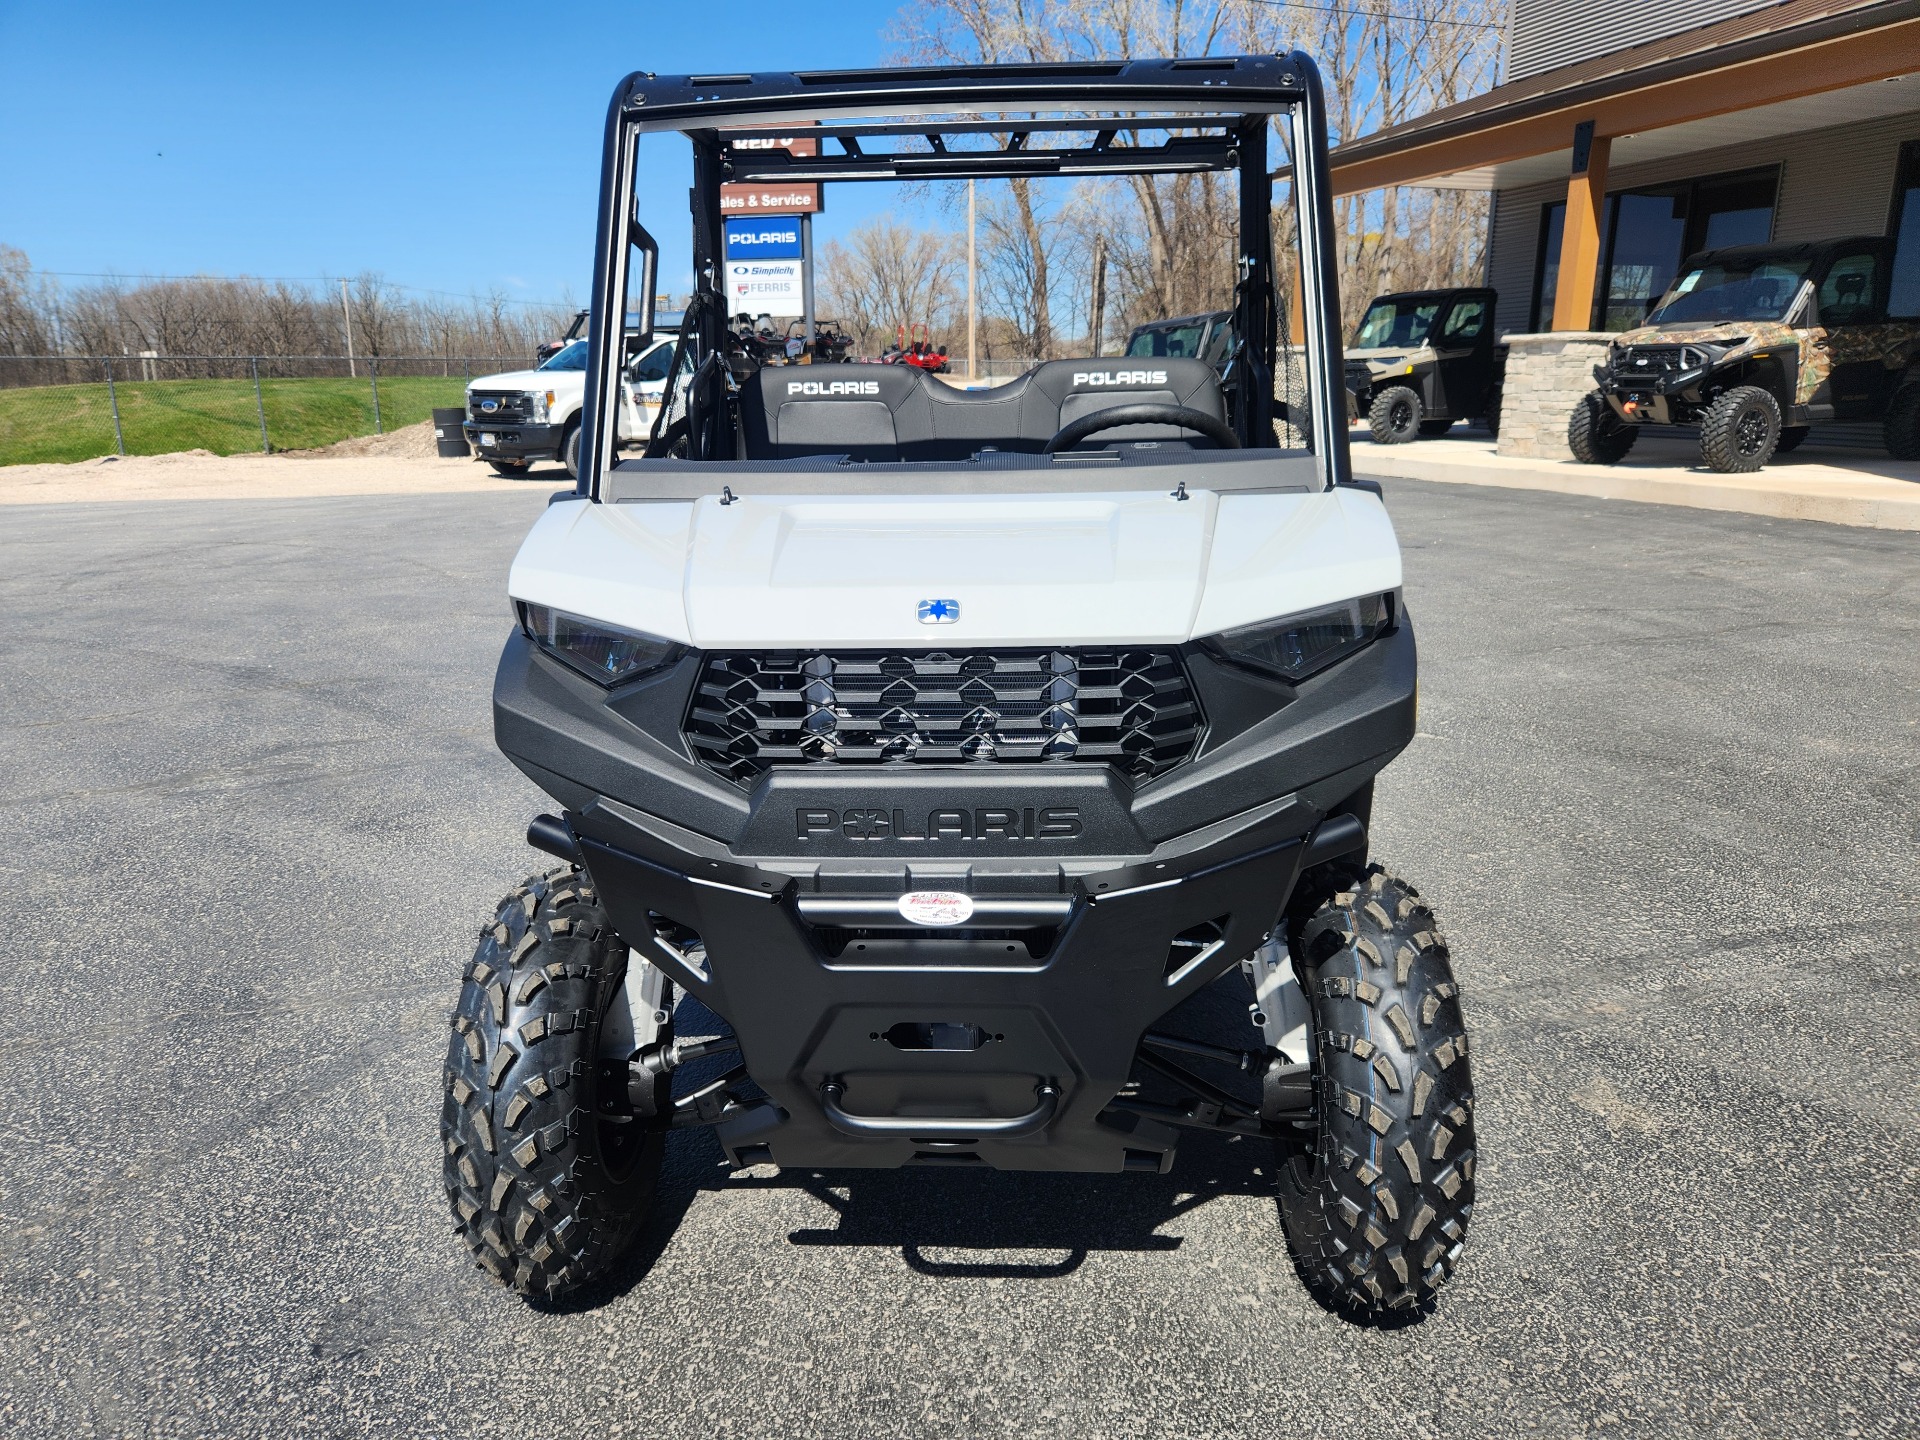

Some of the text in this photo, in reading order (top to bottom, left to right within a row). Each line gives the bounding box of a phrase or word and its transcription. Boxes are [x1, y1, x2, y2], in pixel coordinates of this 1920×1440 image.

[720, 193, 811, 208] ales & Service
[729, 232, 797, 244] POLARIS
[751, 266, 794, 275] Simplicity
[750, 283, 791, 292] FERRIS
[1073, 370, 1168, 386] POLARIS
[787, 381, 880, 395] POLARIS
[796, 808, 1083, 840] POLARIS
